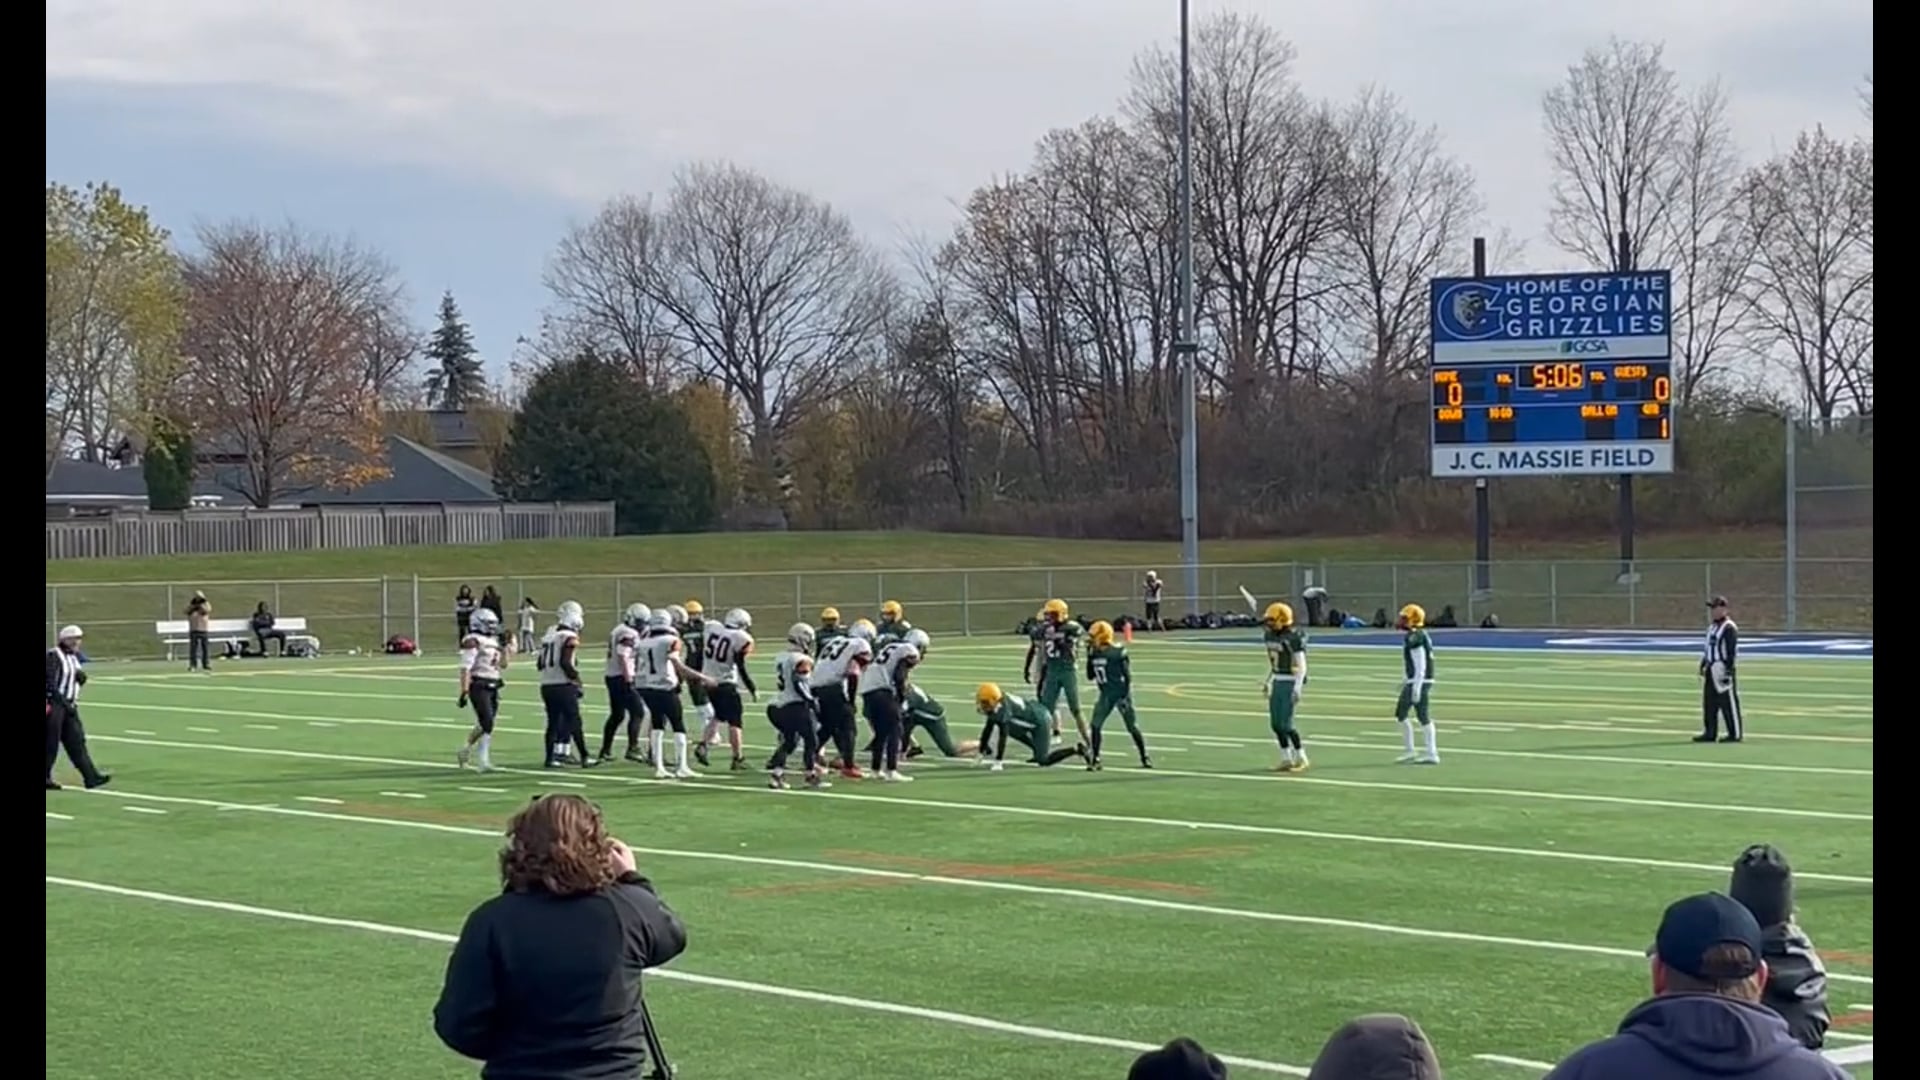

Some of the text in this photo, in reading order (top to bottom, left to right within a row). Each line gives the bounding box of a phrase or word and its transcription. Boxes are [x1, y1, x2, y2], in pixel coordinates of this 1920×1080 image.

[1505, 276, 1664, 295] HOME OF THE
[1506, 294, 1664, 315] GEORGIAN
[1506, 315, 1664, 337] GRIZZLIES
[1573, 340, 1609, 353] GCSA
[1533, 363, 1582, 388] 5:06
[1448, 382, 1462, 406] 0
[1654, 376, 1669, 400] 0
[1661, 417, 1668, 439] 1
[1449, 448, 1655, 470] J. C. MASSIE FIELD
[705, 633, 730, 663] 50
[647, 648, 657, 674] 1
